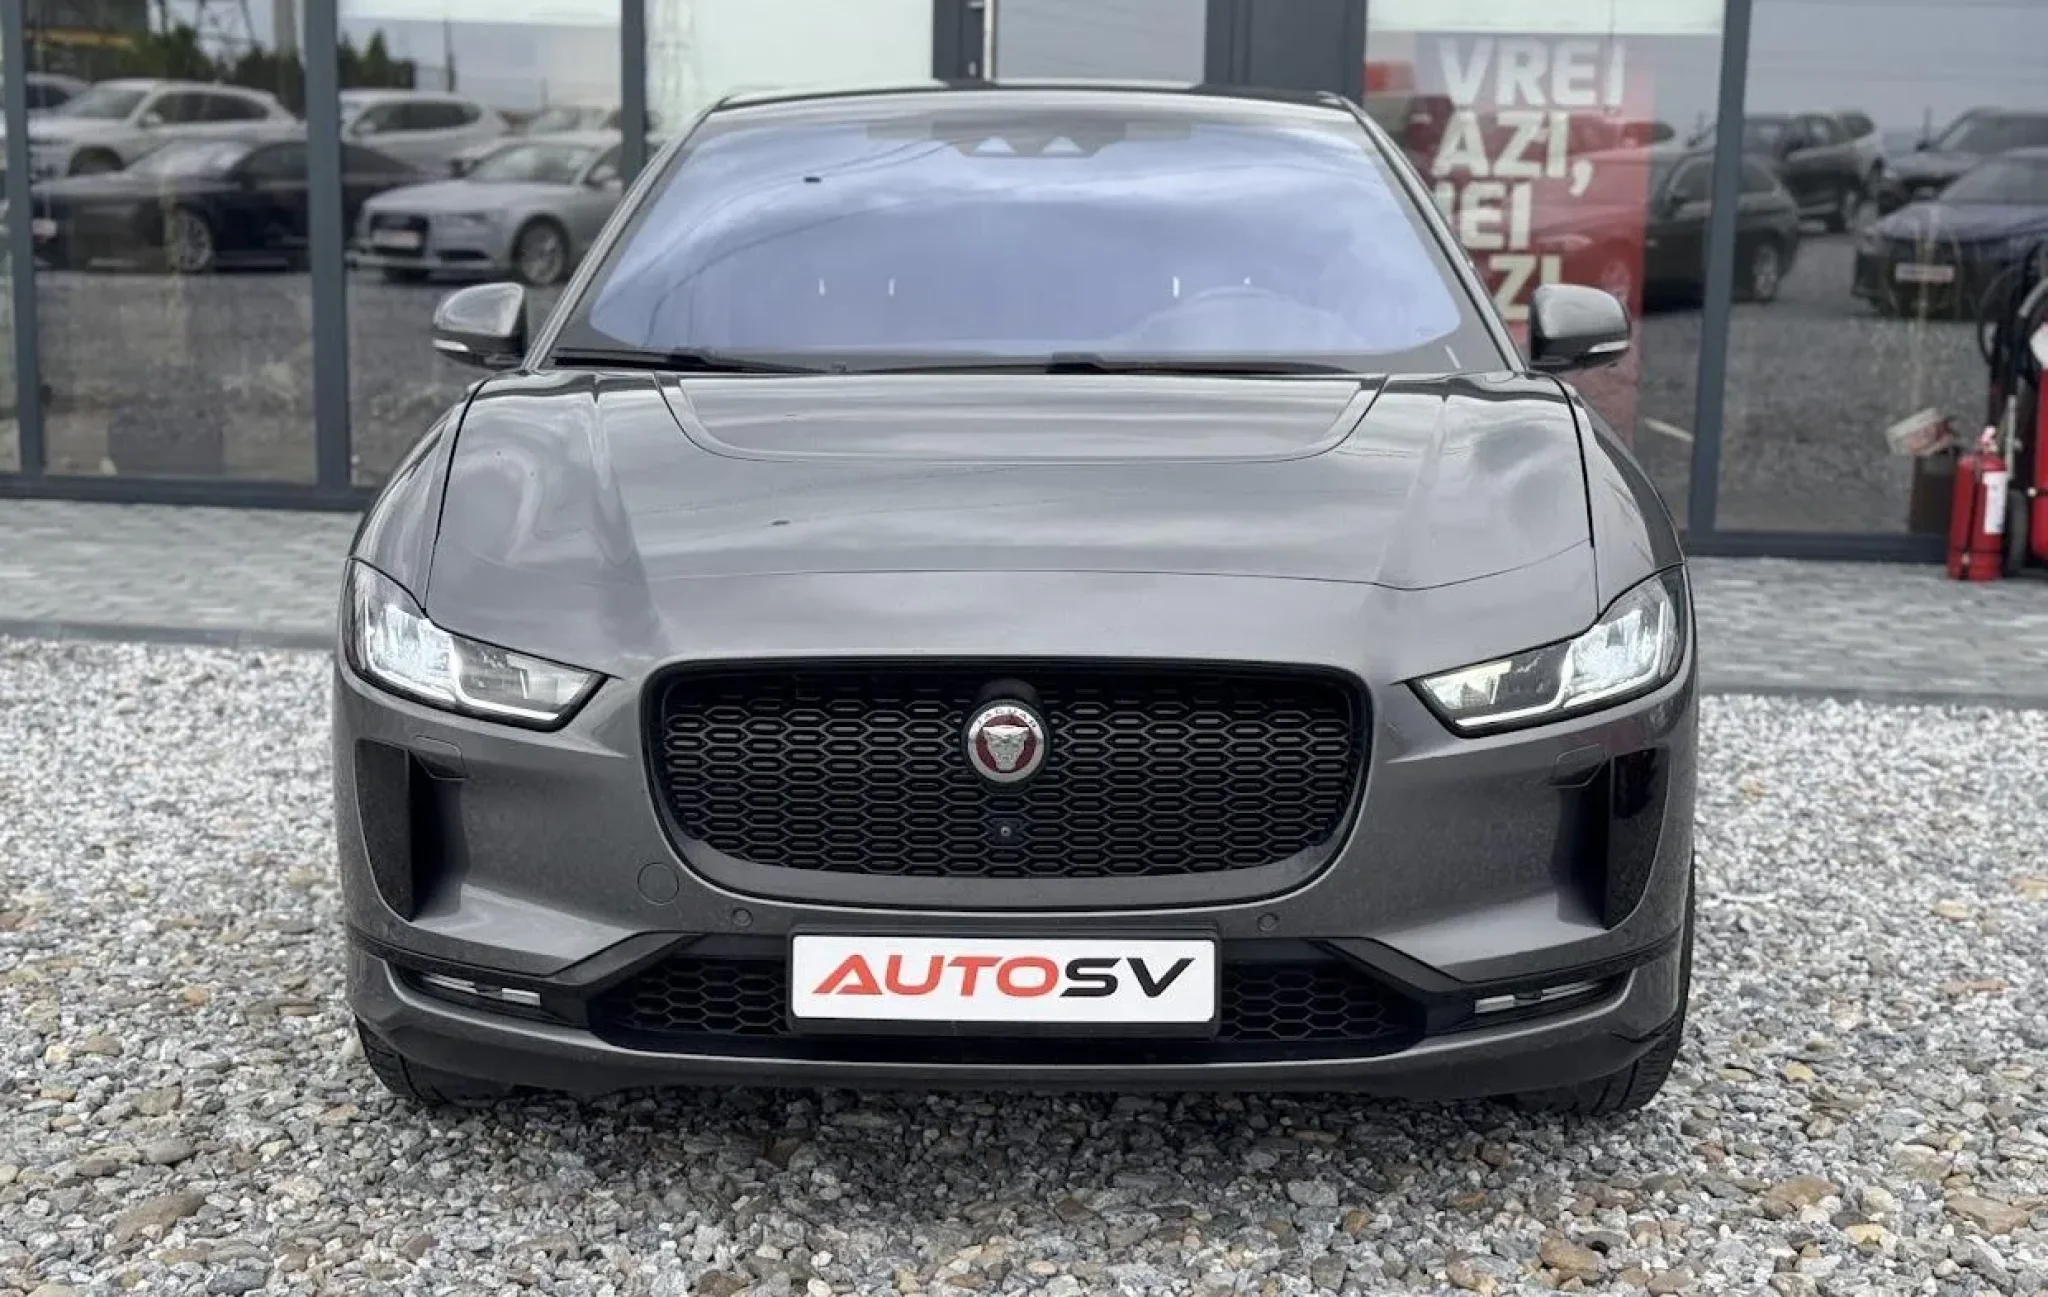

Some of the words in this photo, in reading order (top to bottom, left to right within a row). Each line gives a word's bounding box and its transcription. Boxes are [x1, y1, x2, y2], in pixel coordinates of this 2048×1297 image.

[1440, 39, 1626, 106] VREI
[1432, 110, 1593, 196] AZI,
[811, 954, 1196, 997] AUTOSV
